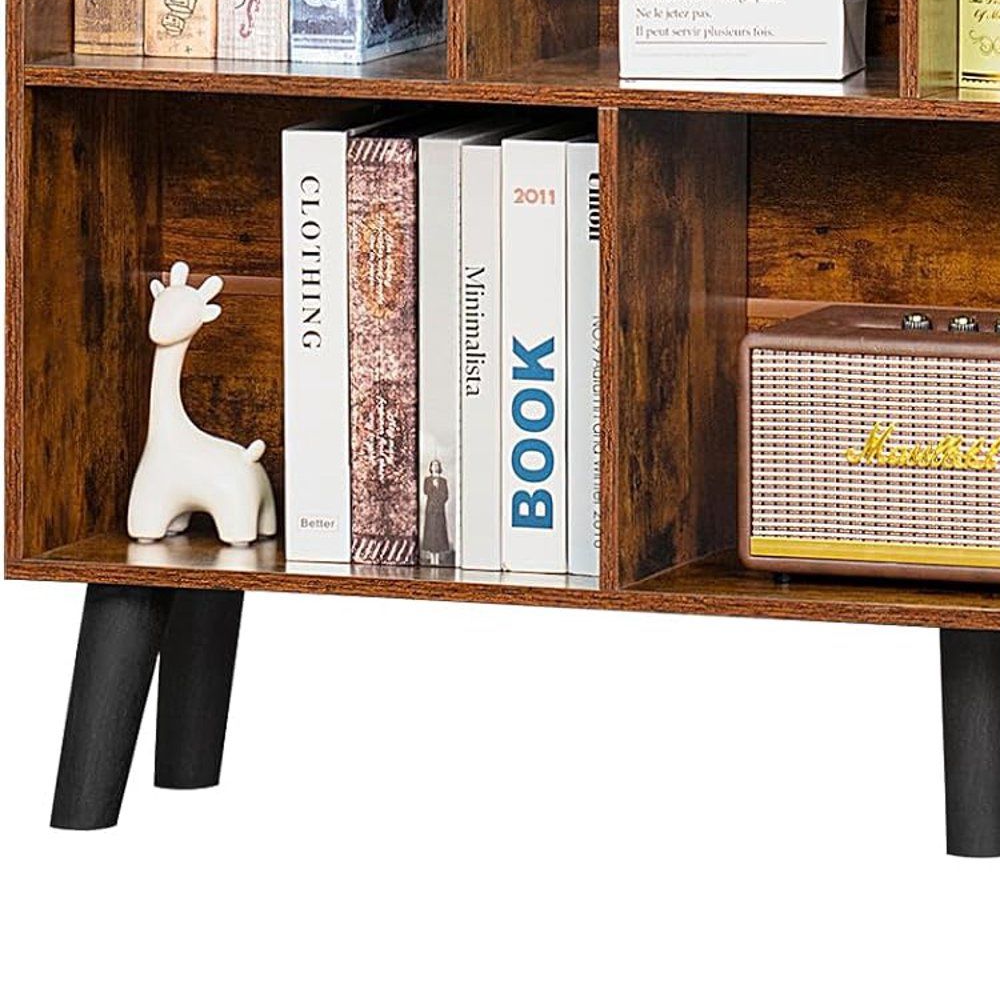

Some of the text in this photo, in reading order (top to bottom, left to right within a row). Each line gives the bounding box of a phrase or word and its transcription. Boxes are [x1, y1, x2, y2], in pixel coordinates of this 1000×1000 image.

[299, 174, 323, 351] CLOTHING
[512, 187, 556, 206] 2011
[465, 265, 487, 398] Minimalista
[511, 335, 556, 530] BOOK
[300, 516, 336, 530] Better
